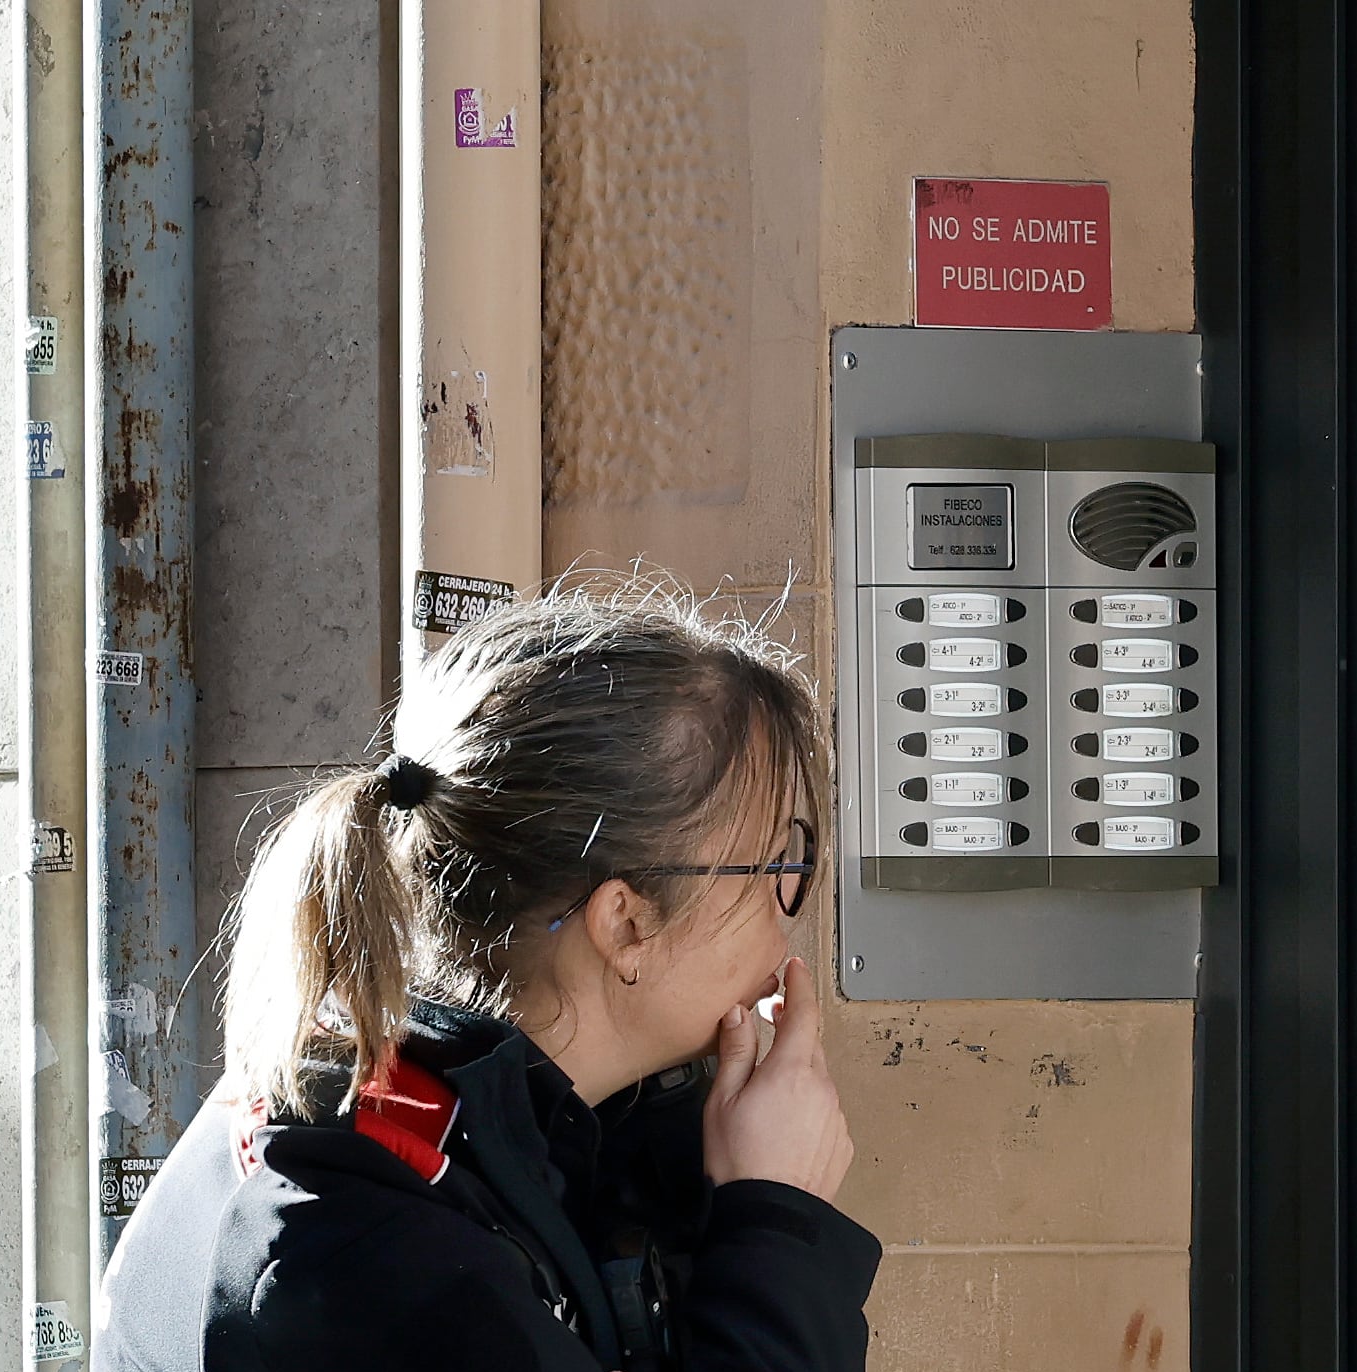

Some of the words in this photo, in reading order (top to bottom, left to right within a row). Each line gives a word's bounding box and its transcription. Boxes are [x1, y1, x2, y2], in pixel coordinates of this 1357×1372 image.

[928, 216, 960, 241] NO
[972, 217, 1000, 243] SE
[1013, 218, 1098, 246] ADMITE
[942, 265, 1086, 294] PUBLICIDAD
[944, 499, 982, 511] FIBECO
[921, 514, 1003, 527] INSTALACIONES
[438, 575, 491, 594] CERRAJERO
[492, 583, 502, 596] 24
[435, 591, 459, 619] 632
[460, 595, 486, 622] 269
[115, 660, 139, 677] 668
[121, 1158, 165, 1171] CERRAJE
